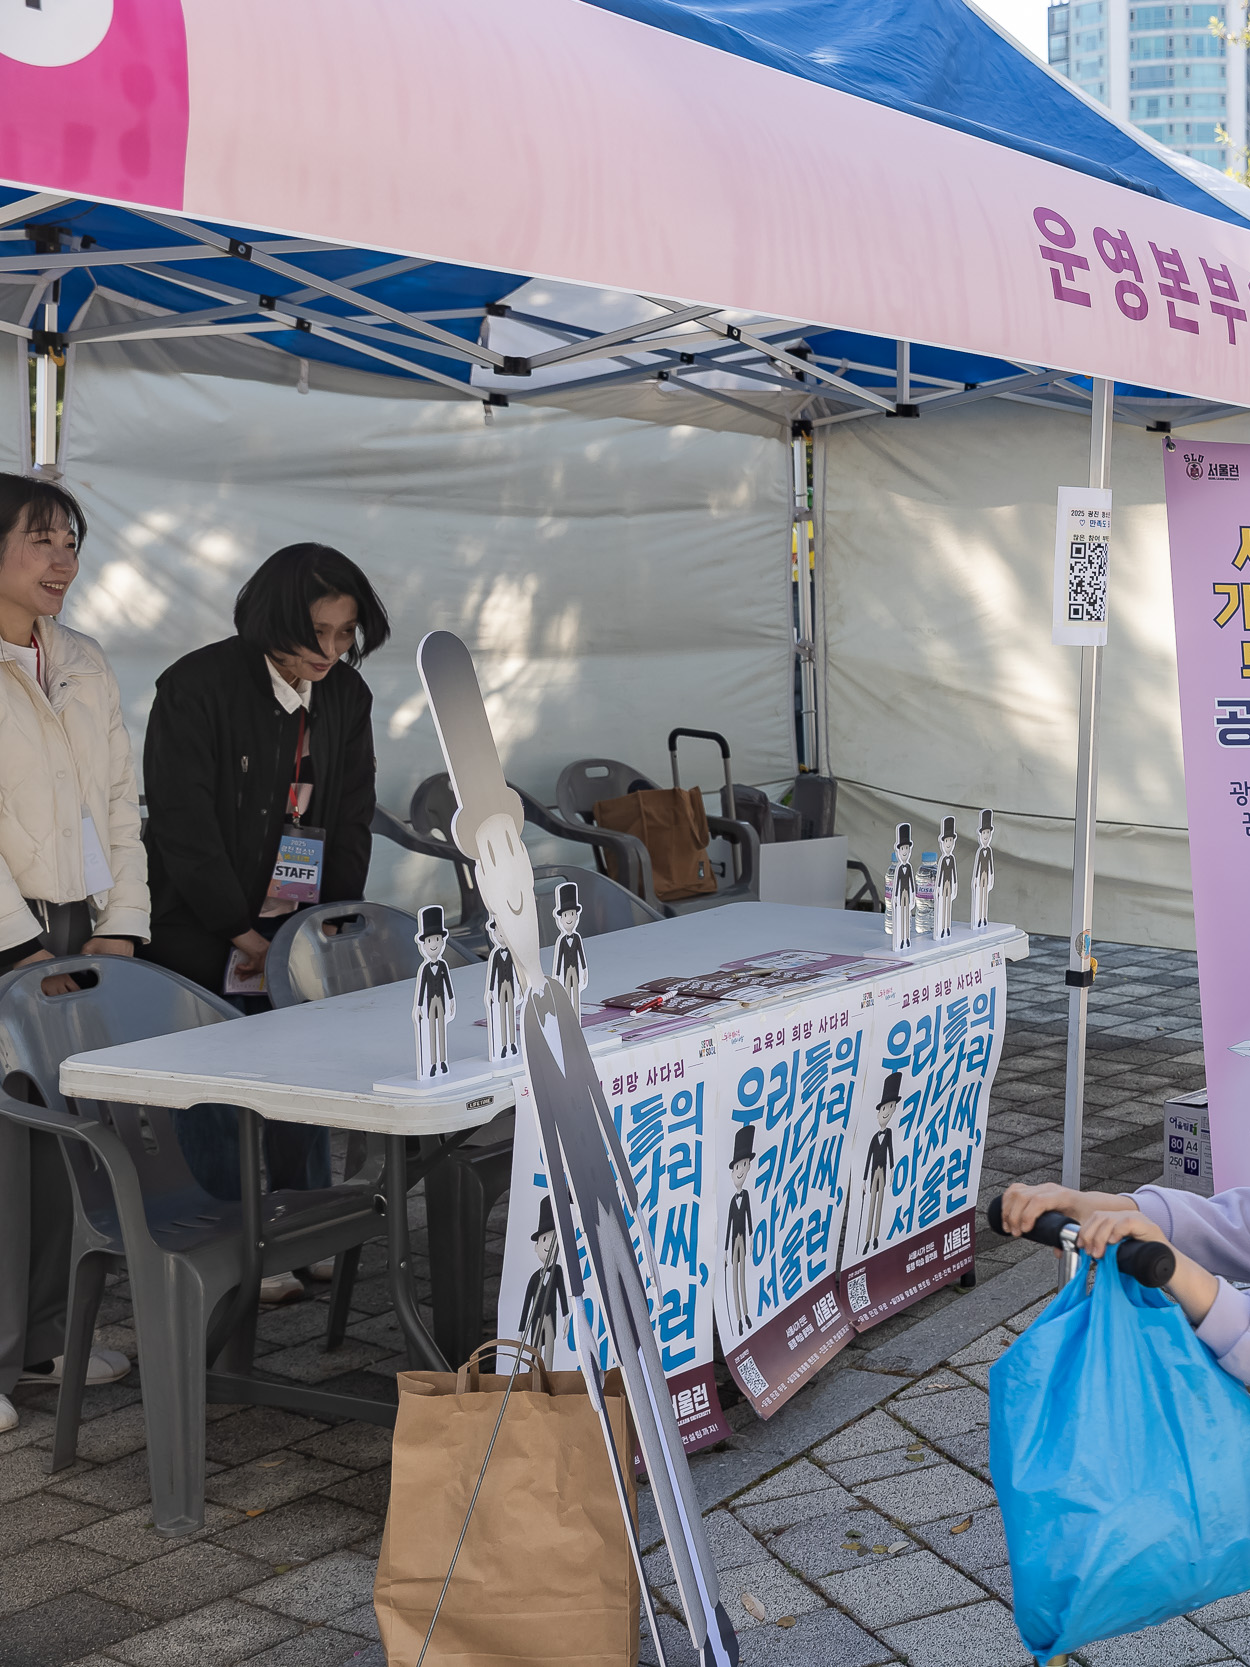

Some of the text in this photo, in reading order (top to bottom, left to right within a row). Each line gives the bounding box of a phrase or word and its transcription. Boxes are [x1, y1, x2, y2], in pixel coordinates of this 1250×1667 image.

[1183, 453, 1205, 463] SLU
[1208, 463, 1240, 478] 서울런
[1071, 509, 1085, 517] 2025
[275, 865, 315, 880] STAFF
[902, 985, 929, 1009] 교육의
[935, 978, 952, 998] 희망
[957, 968, 982, 990] 사다리
[752, 1028, 785, 1054] 교육의
[792, 1020, 812, 1042] 희망
[819, 1010, 849, 1034] 사다리
[882, 987, 996, 1078] 우리들의
[611, 1059, 685, 1097] 희망 사다리
[731, 1030, 863, 1131] 우리들의
[898, 1034, 993, 1142] 키다리
[755, 1081, 855, 1204] 키다리
[892, 1080, 982, 1197] 아저씨,
[1171, 1138, 1198, 1152] 80 A4
[1170, 1156, 1197, 1169] 250 10
[752, 1133, 844, 1267] 아저씨,
[886, 1145, 973, 1240] 서울런
[943, 1223, 971, 1255] 서울런
[757, 1205, 833, 1317] 서울런
[812, 1290, 838, 1327] 서울런
